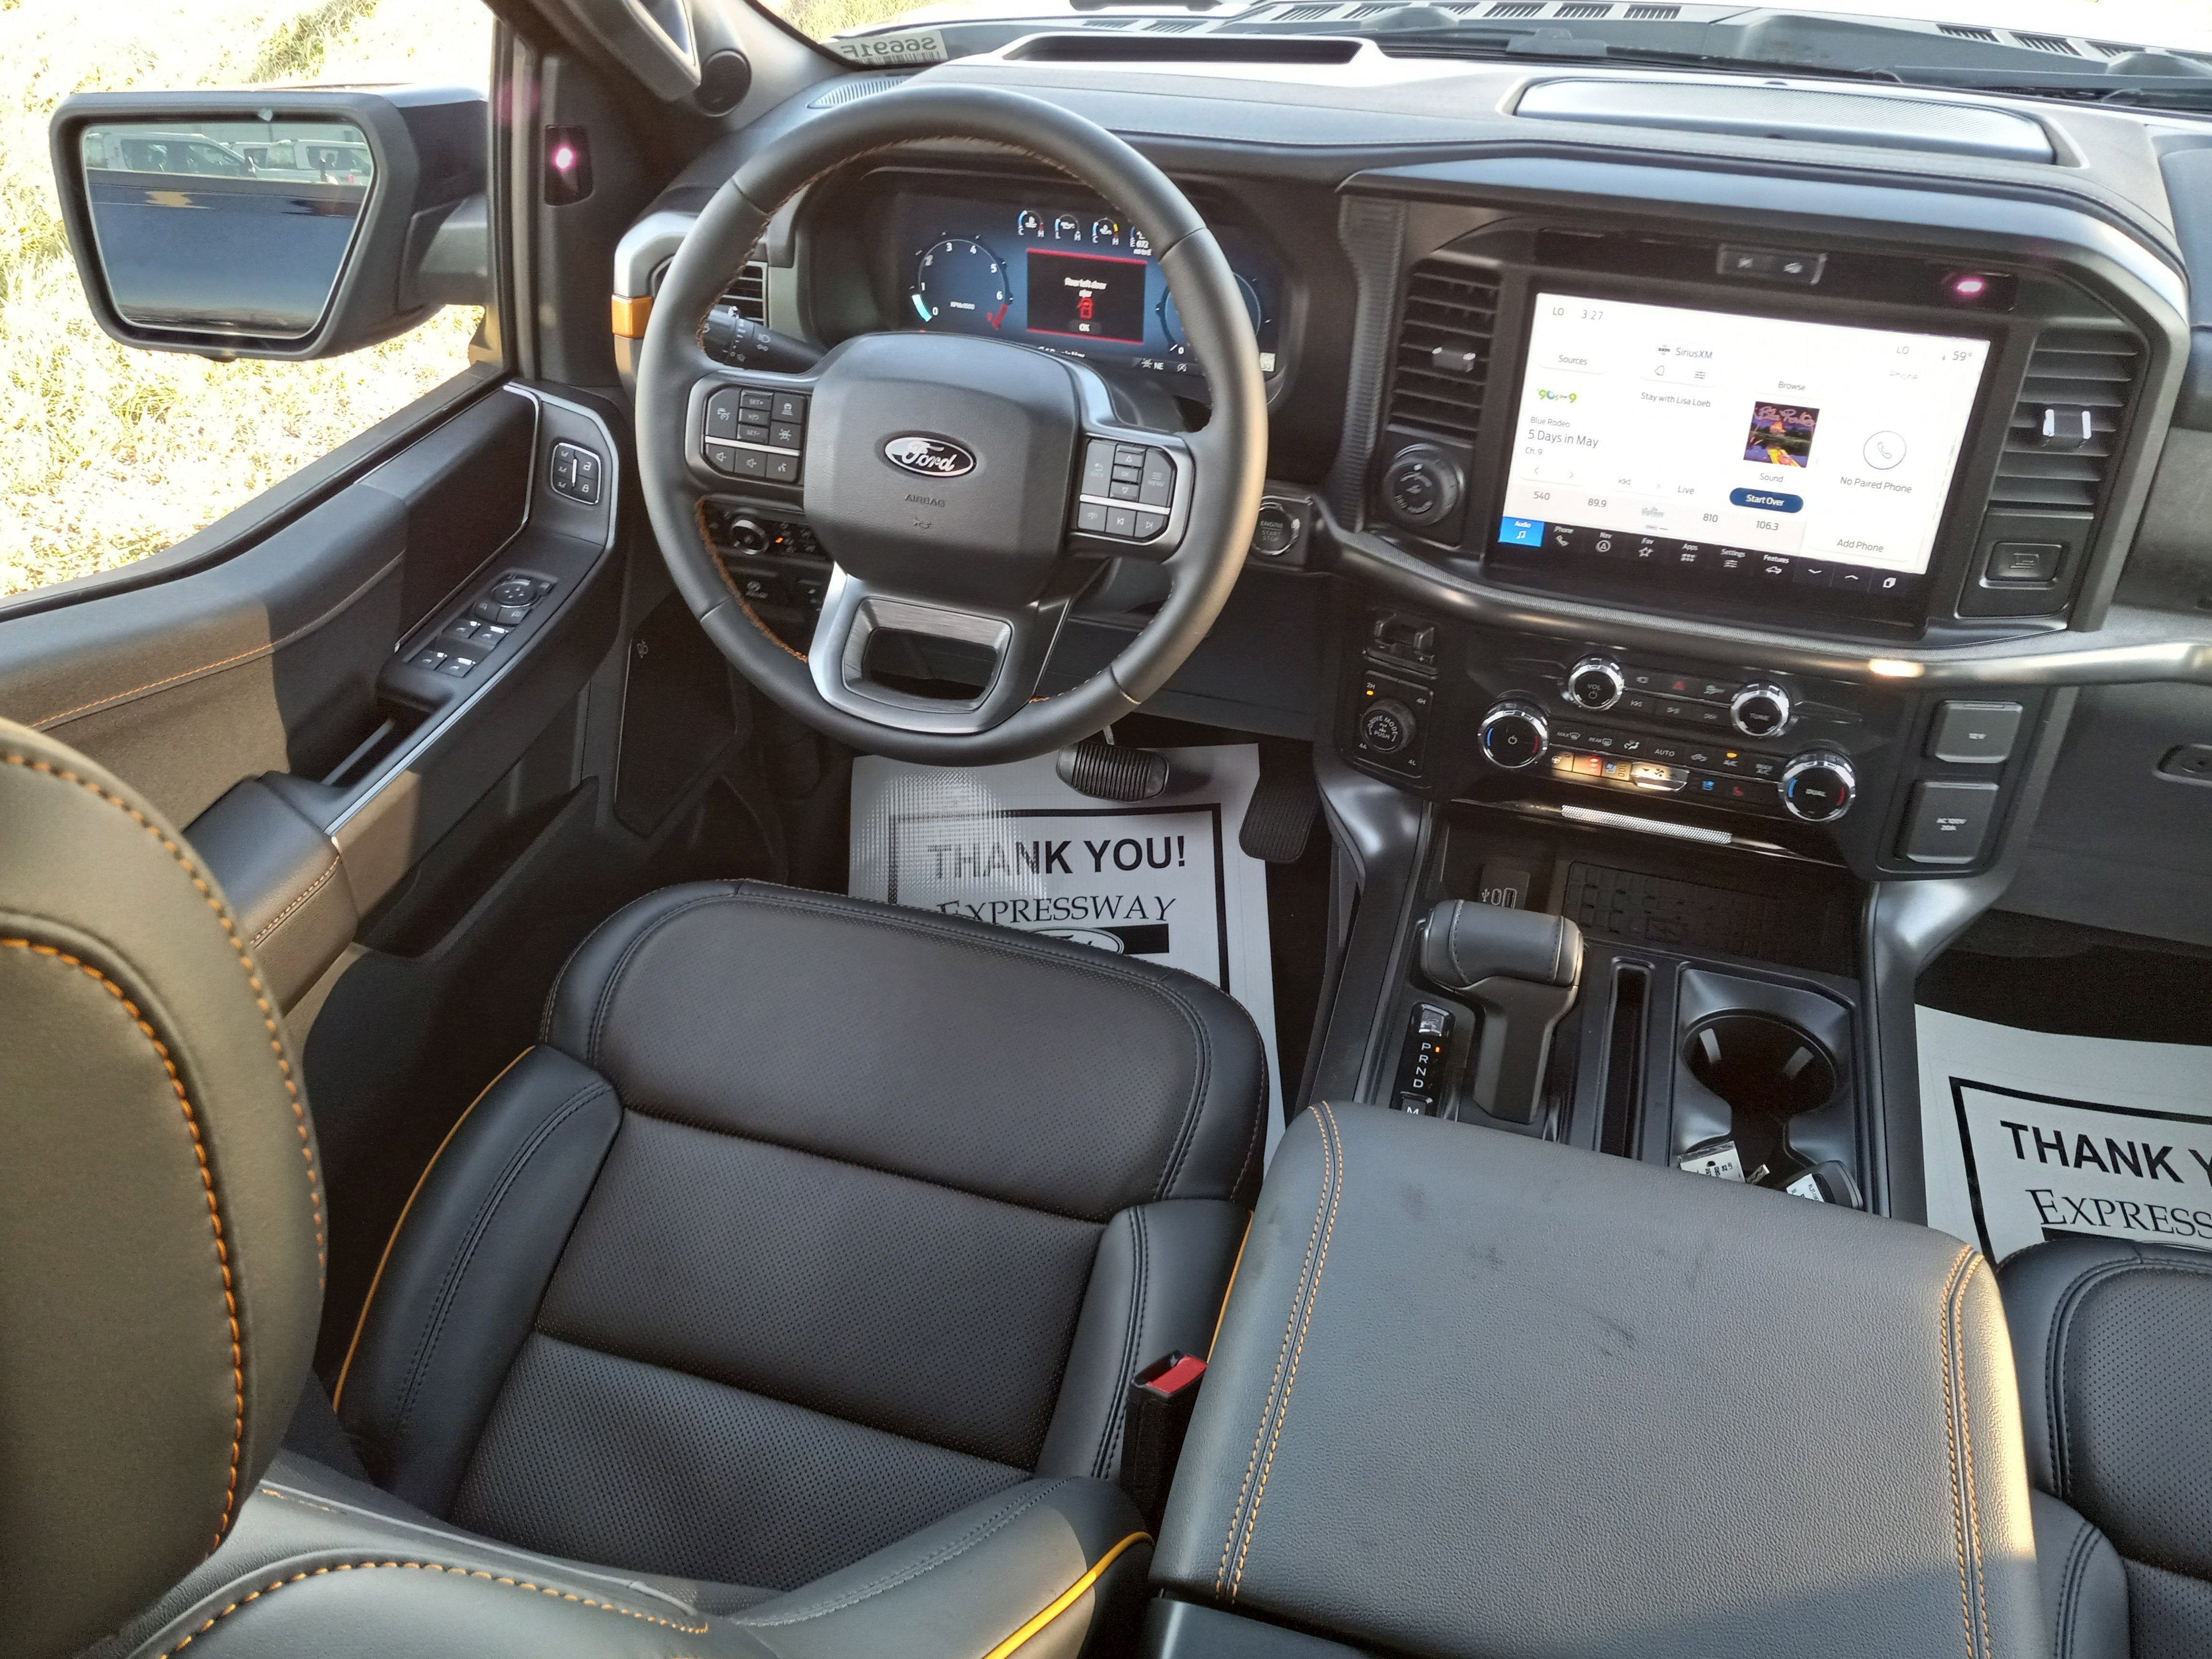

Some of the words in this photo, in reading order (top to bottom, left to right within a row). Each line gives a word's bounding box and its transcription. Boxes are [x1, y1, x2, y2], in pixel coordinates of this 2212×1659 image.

[946, 242, 952, 252] 3
[970, 245, 977, 254] 4
[925, 255, 933, 265] 2
[990, 264, 997, 273] 5
[921, 282, 926, 291] 1
[997, 291, 1003, 300] 6
[932, 307, 938, 315] 0
[1553, 307, 1564, 316] LO
[1675, 348, 1713, 359] SiriusXM
[1896, 346, 1910, 355] LO
[1558, 355, 1588, 366] Sources
[1778, 381, 1806, 392] Browse
[1641, 392, 1657, 402] Stay
[1659, 395, 1675, 403] with
[1677, 397, 1691, 406] Lisa
[1693, 399, 1711, 408] Loeb
[1530, 417, 1546, 425] Blue
[1547, 419, 1571, 428] Rodeo
[1528, 429, 1535, 440] 5
[1537, 431, 1562, 444] Days
[1564, 433, 1574, 445] in
[1576, 435, 1599, 449] May
[902, 440, 958, 471] Ford
[1759, 473, 1784, 483] Sound
[1678, 485, 1695, 495] Live
[1840, 477, 1852, 485] No
[1854, 479, 1882, 490] Paired
[1884, 482, 1912, 493] Phone
[904, 494, 946, 507] AIRBAG
[1533, 491, 1551, 500] 540
[1745, 494, 1766, 504] Start
[1766, 497, 1785, 507] Over
[1587, 498, 1607, 508] 89.9
[1703, 513, 1719, 523] 810
[1514, 520, 1532, 529] Audio
[1756, 520, 1779, 531] 106.3
[1554, 526, 1574, 534] Phone
[1641, 537, 1654, 545] Fav
[1837, 539, 1854, 548] Add
[1856, 541, 1884, 553] Phone
[1682, 543, 1698, 552] Apps
[1719, 548, 1746, 558] Settings
[1763, 554, 1790, 565] Features
[1587, 683, 1601, 691] VOL
[1654, 748, 1675, 757] AUTO
[926, 840, 1073, 879] THANK
[1083, 835, 1186, 874] YOU!
[1421, 1042, 1431, 1051] P
[1419, 1055, 1429, 1063] R
[1416, 1066, 1427, 1076] N
[1413, 1079, 1424, 1088] D
[2000, 1120, 2185, 1184] THANK
[2025, 1190, 2212, 1239] EXPRESS
